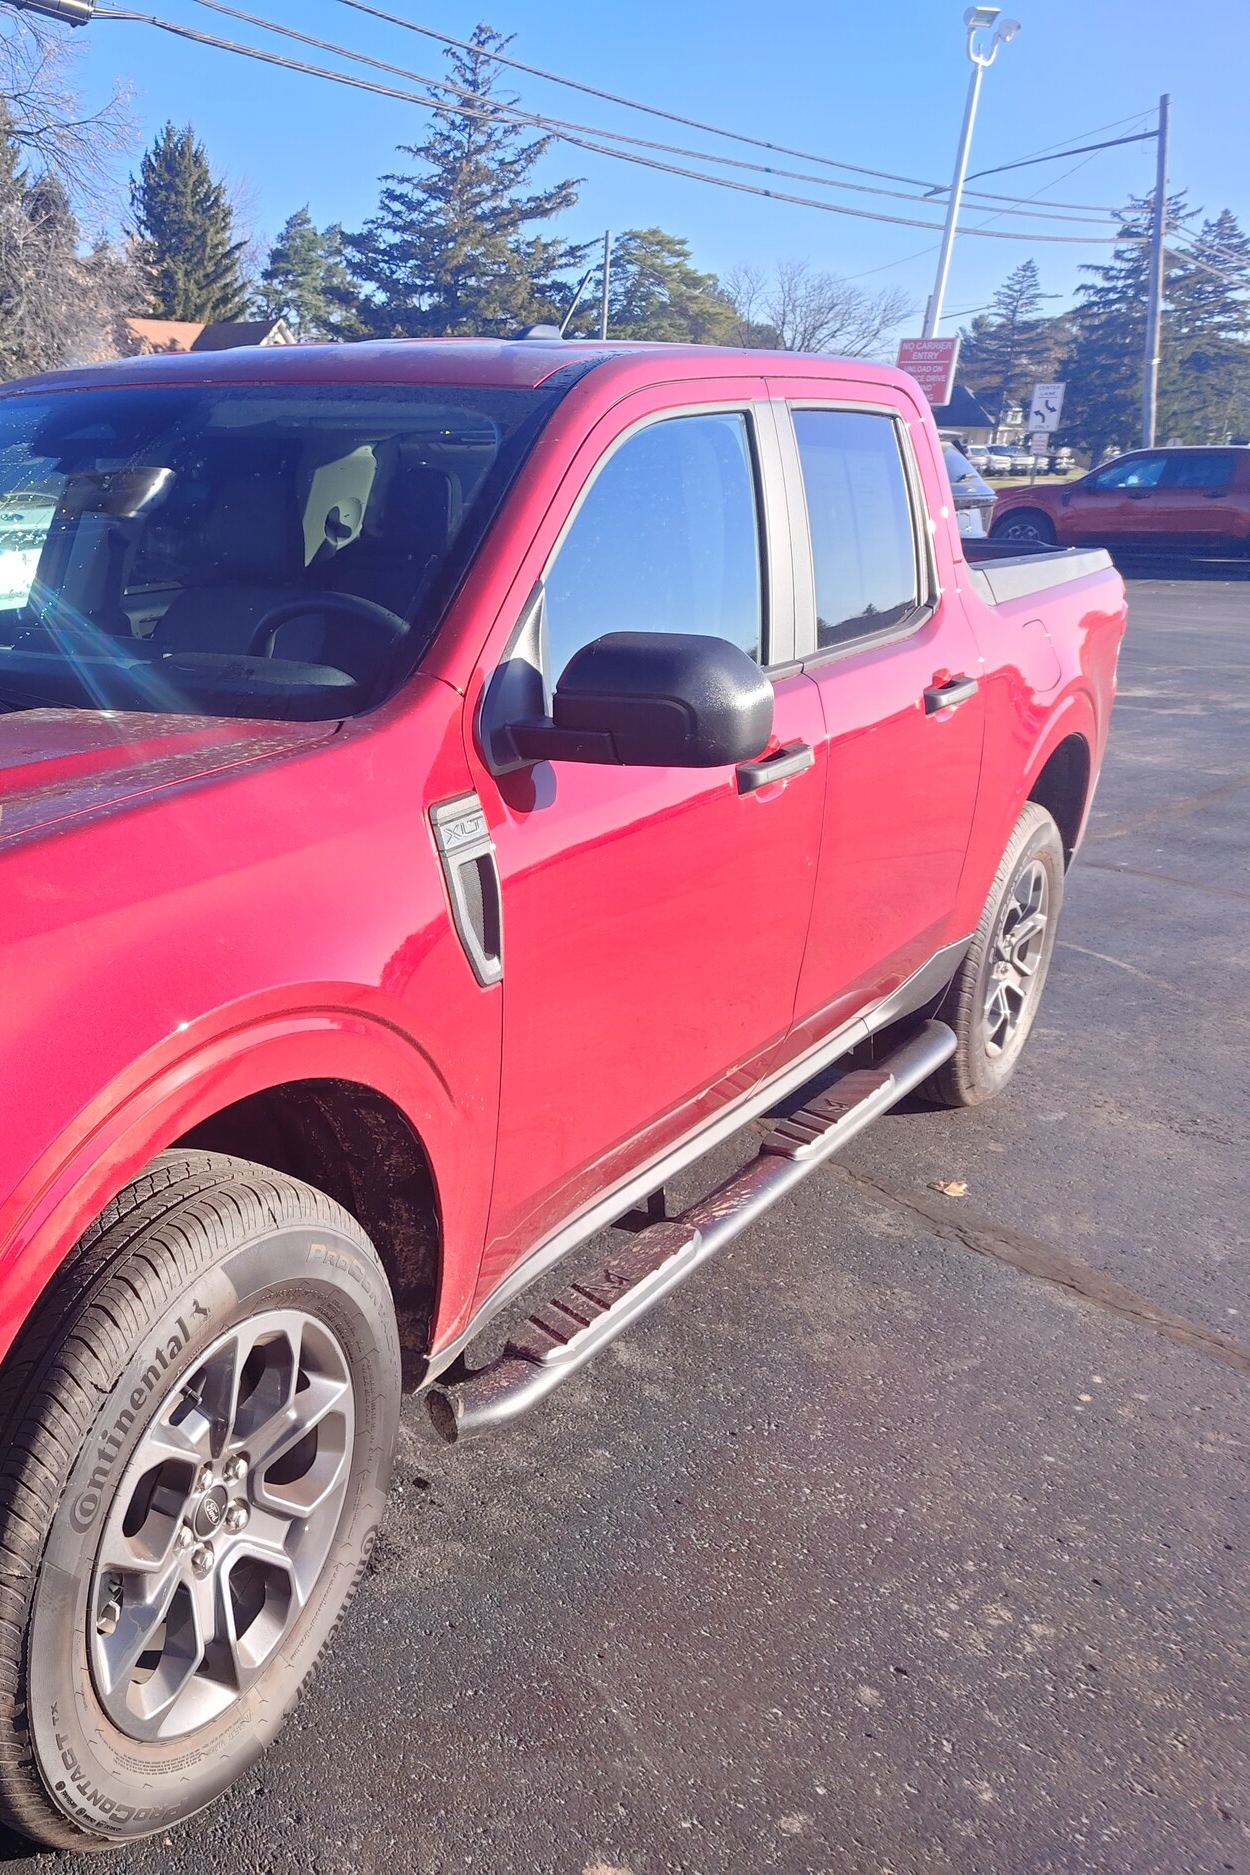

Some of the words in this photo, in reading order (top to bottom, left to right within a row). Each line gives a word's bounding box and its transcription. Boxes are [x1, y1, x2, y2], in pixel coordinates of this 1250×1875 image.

[902, 341, 915, 350] NO
[916, 341, 953, 350] CARRIER
[933, 365, 944, 373] ON
[925, 374, 948, 382] DRIVE
[443, 815, 484, 845] XLT
[69, 1315, 191, 1535] Continental
